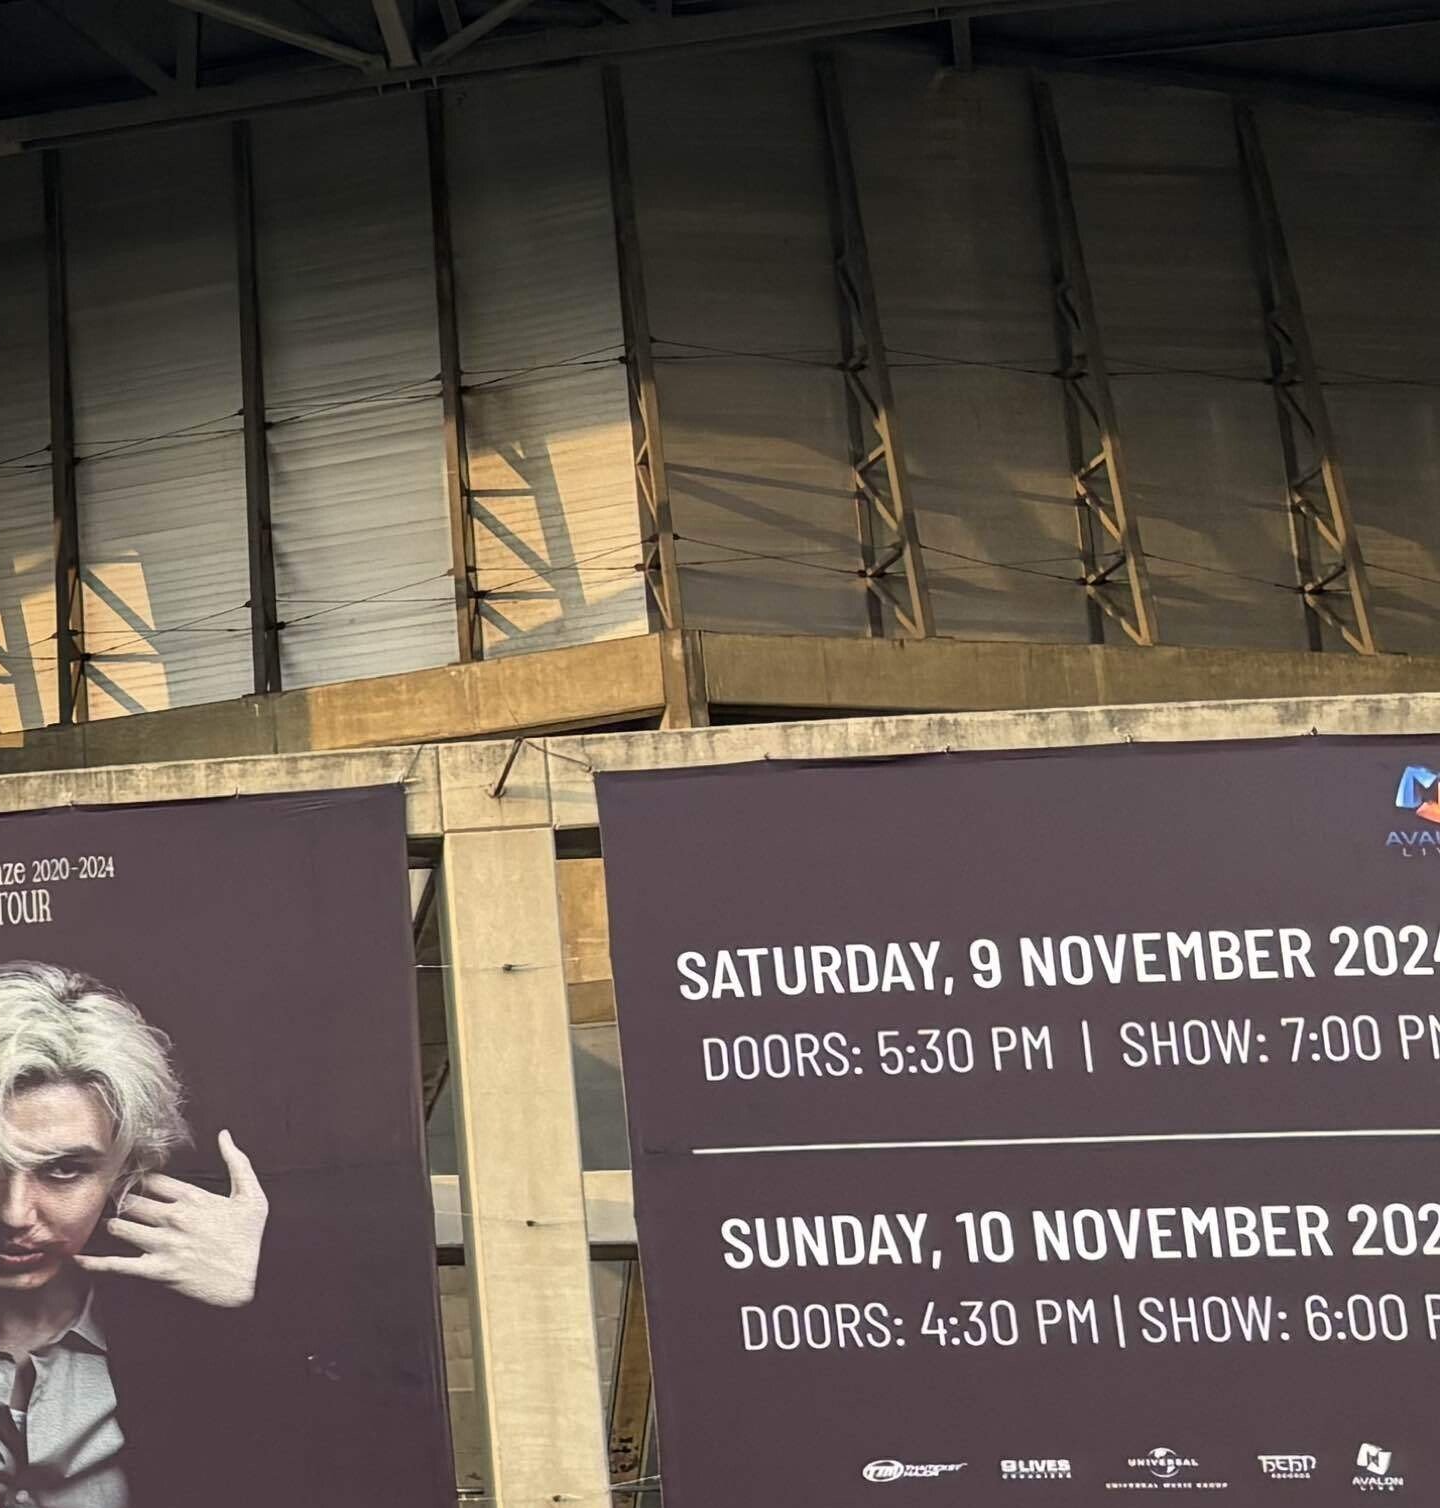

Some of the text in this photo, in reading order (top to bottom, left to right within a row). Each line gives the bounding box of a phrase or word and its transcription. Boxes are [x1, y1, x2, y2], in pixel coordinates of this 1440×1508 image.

[1385, 830, 1440, 847] AVA
[31, 856, 115, 884] 2020-2024
[676, 924, 1440, 1001] SATURDAY, 9 NOVEMBER 202
[702, 1031, 864, 1082] DOORS:
[877, 1027, 975, 1075] 5:30
[990, 1025, 1055, 1072] PM
[1120, 1017, 1271, 1069] SHOW:
[1280, 1014, 1382, 1062] 7:00
[721, 1212, 942, 1270] SUNDAY,
[954, 1210, 1016, 1264] 10
[1032, 1204, 1334, 1261] NOVEMBER
[740, 1302, 906, 1351] DOORS:
[920, 1299, 1020, 1347] 4:30
[1035, 1298, 1100, 1345] PM
[1140, 1294, 1290, 1344] SHOW:
[1304, 1293, 1409, 1342] 6:00
[1127, 1458, 1199, 1468] UNIVERSAL
[1352, 1476, 1404, 1487] AVALON
